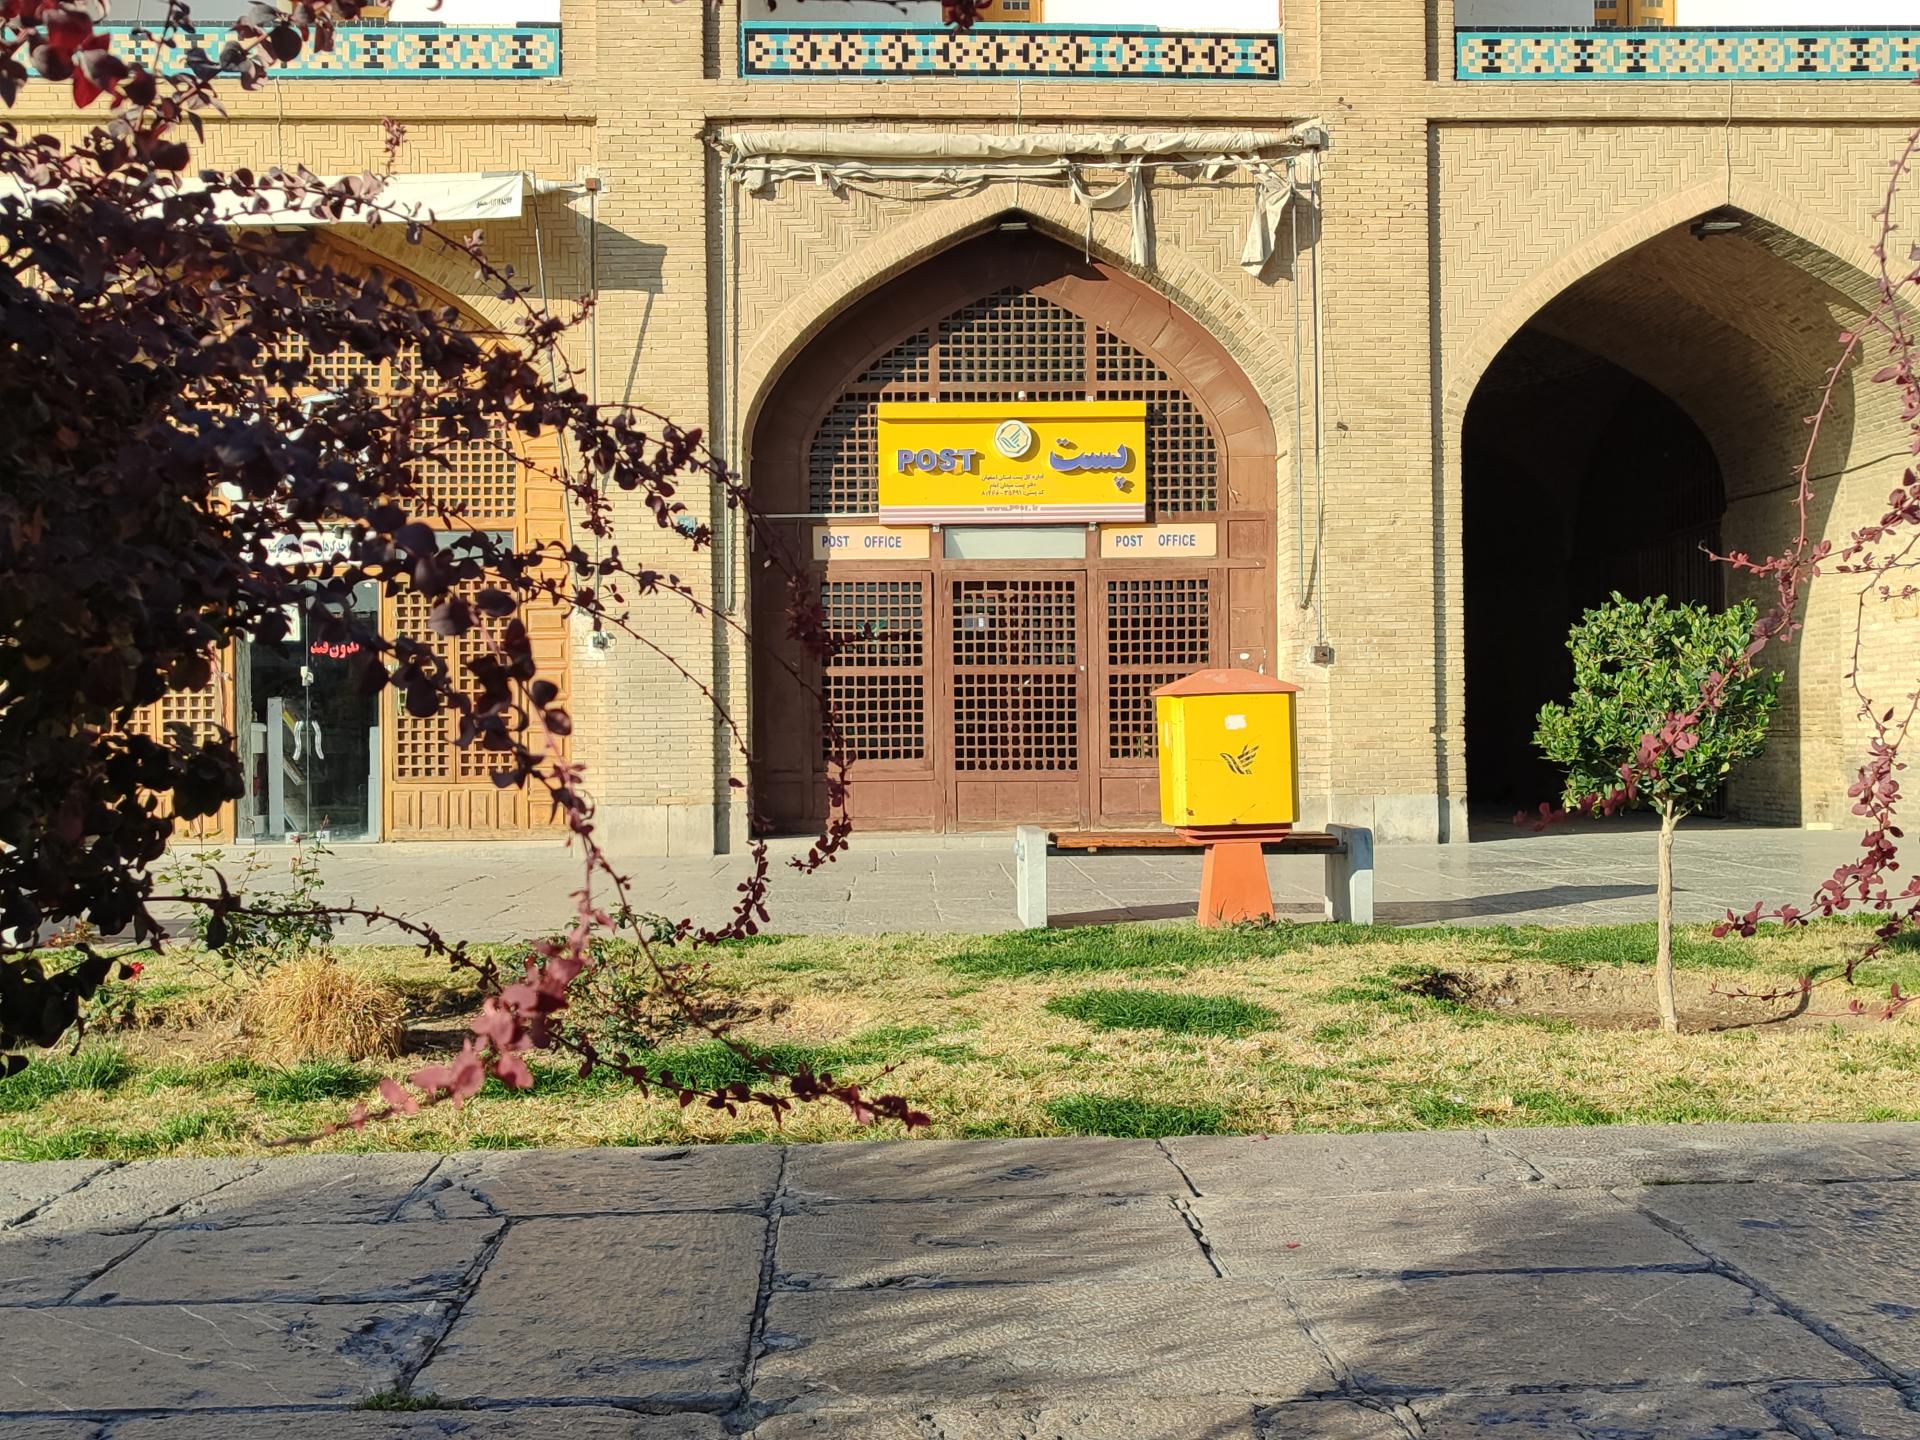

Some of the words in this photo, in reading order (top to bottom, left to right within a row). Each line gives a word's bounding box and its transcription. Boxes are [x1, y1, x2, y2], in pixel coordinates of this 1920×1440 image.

[897, 448, 976, 471] POST
[1049, 437, 1128, 491] پست
[821, 535, 850, 548] POST
[864, 535, 902, 548] OFFICE
[1115, 534, 1144, 548] POST
[1158, 534, 1196, 547] OFFICE
